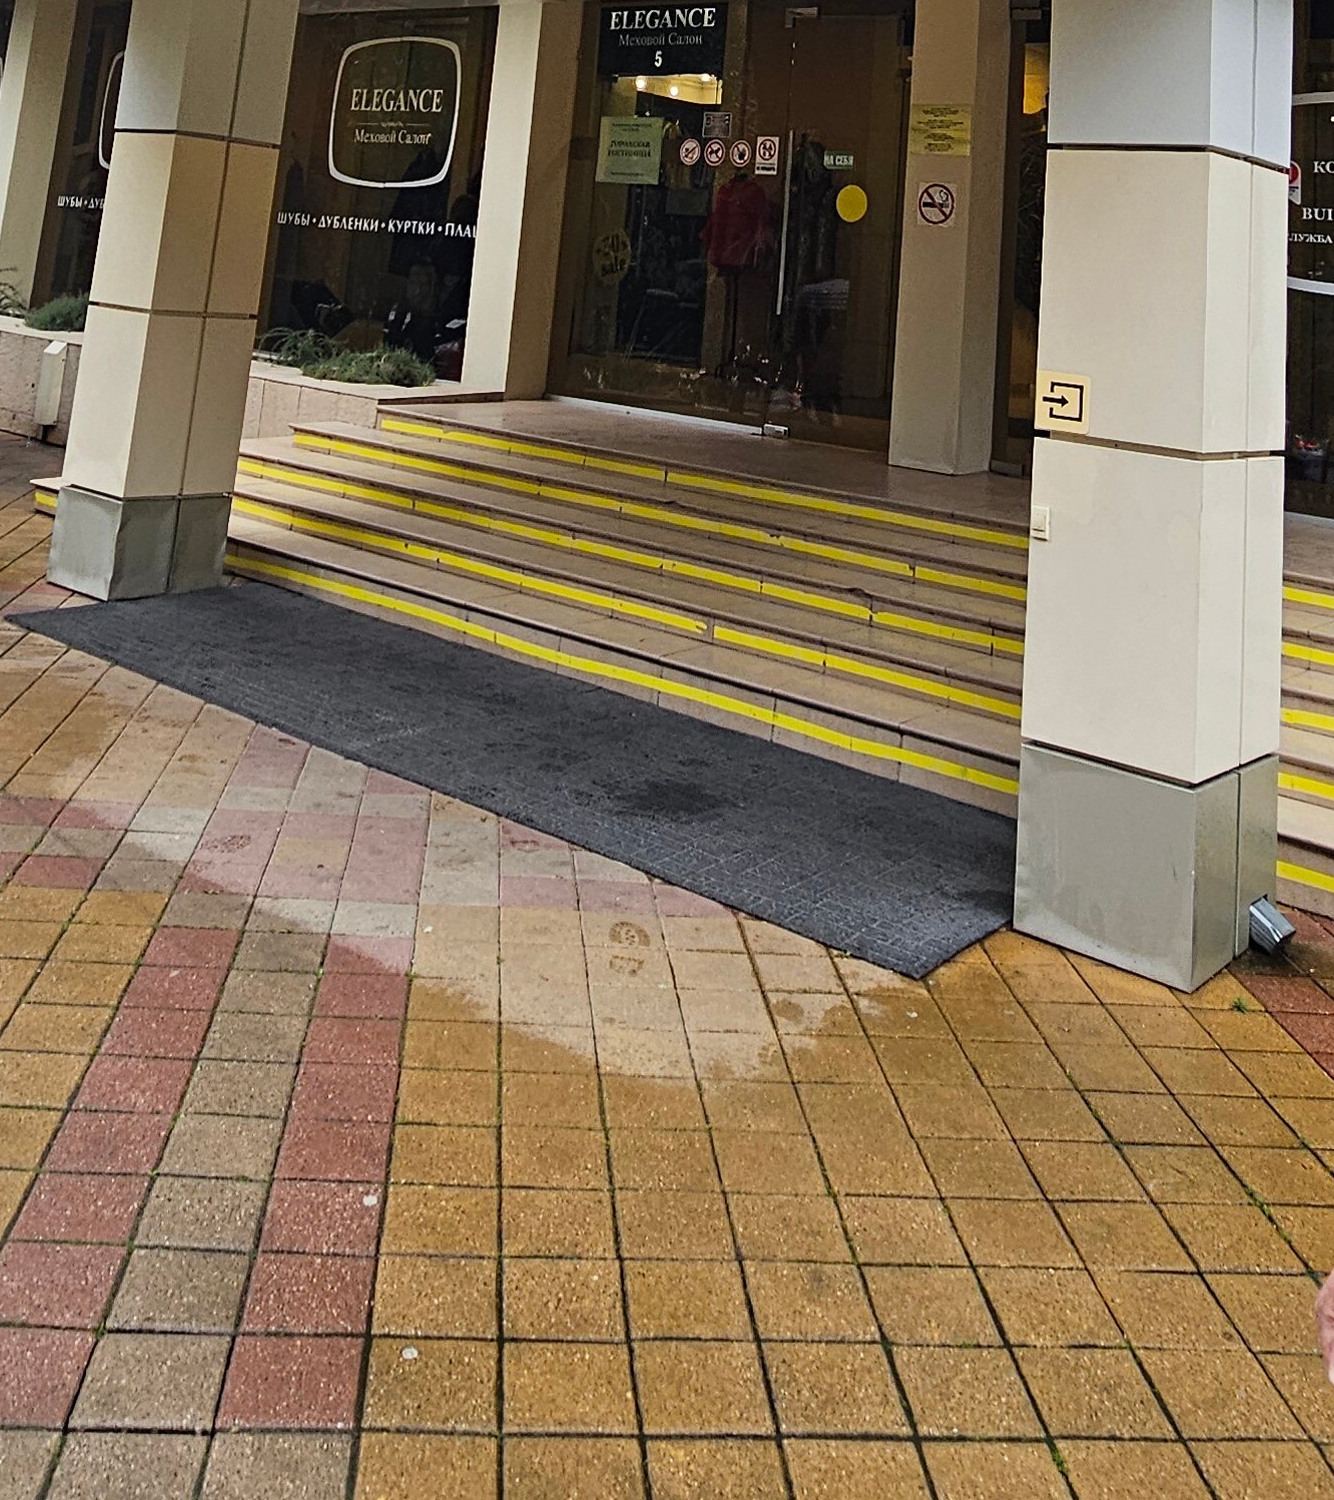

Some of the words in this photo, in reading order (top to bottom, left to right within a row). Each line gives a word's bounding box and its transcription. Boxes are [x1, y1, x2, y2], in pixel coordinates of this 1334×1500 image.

[610, 8, 716, 30] ELEGANCE
[619, 33, 665, 46] Меховой
[668, 32, 702, 45] Салон
[654, 50, 663, 67] 5
[350, 89, 444, 112] ELEGANCE
[354, 128, 396, 143] Меховой
[398, 129, 433, 145] Салон
[57, 195, 83, 207] ШУБЫ
[277, 211, 310, 226] ШУБЫ
[317, 214, 378, 232] ДУБЛЕНКИ
[387, 219, 435, 235] КУРТКИ
[1288, 233, 1333, 245] ЛУЖБА
